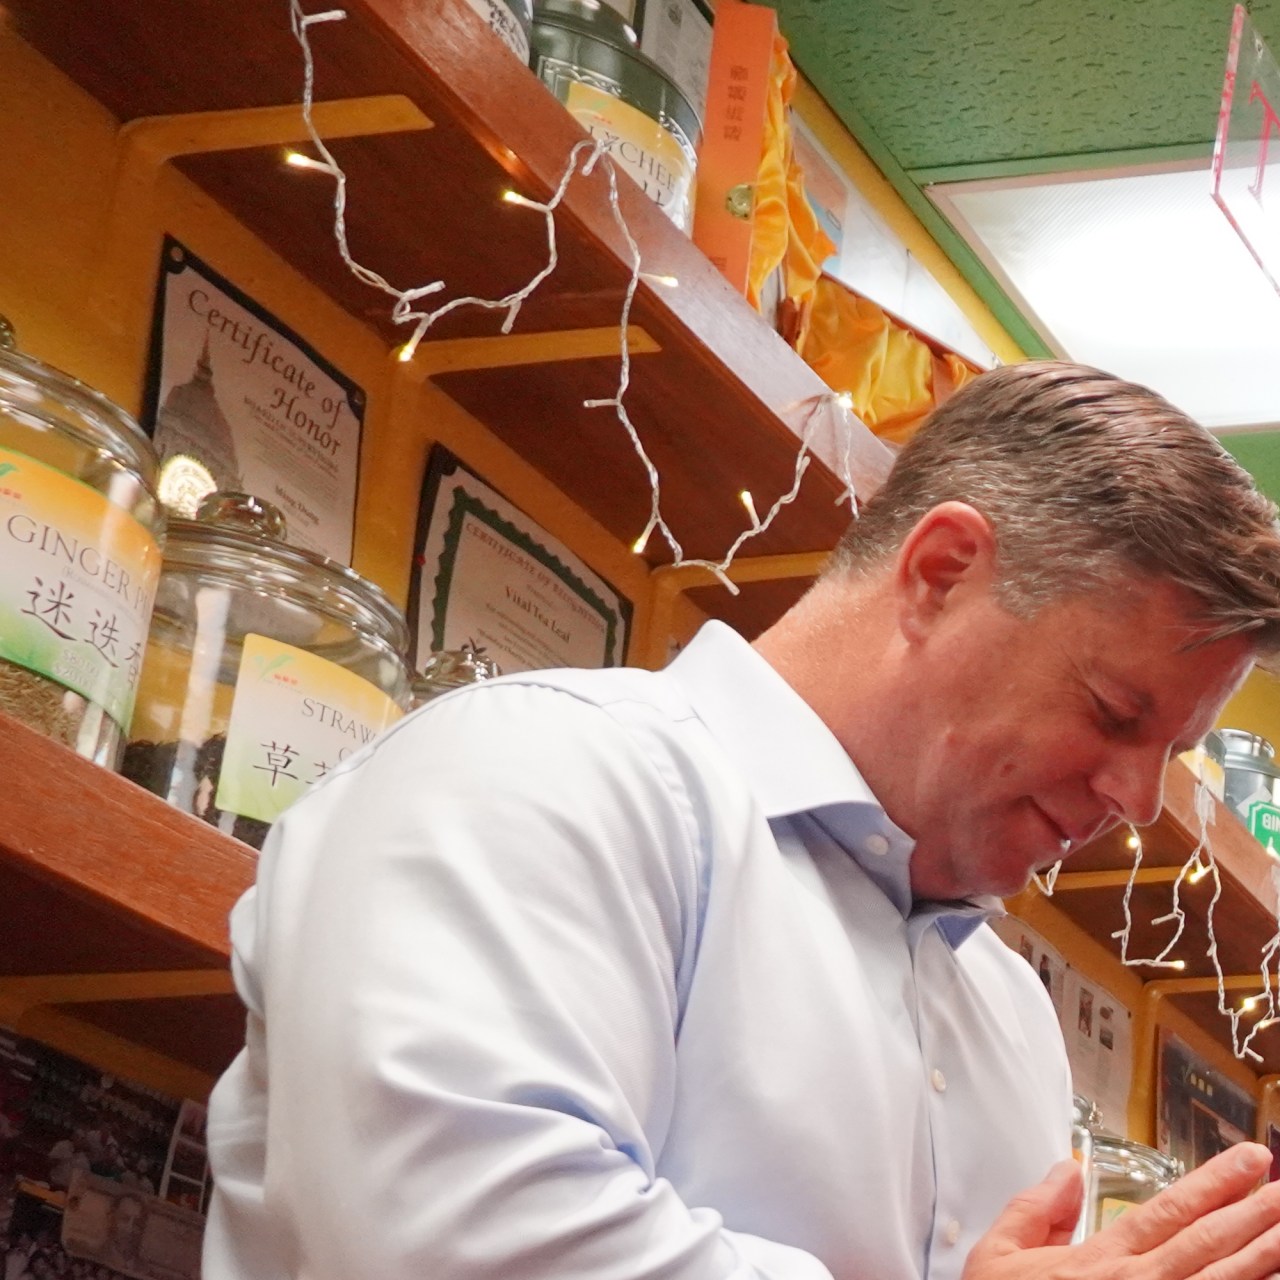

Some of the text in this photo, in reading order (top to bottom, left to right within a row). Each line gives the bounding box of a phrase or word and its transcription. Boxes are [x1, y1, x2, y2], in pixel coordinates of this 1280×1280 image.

[188, 290, 346, 428] Certificate of
[270, 387, 341, 455] Honor
[7, 514, 130, 600] GINGER
[301, 697, 378, 744] STRAW
